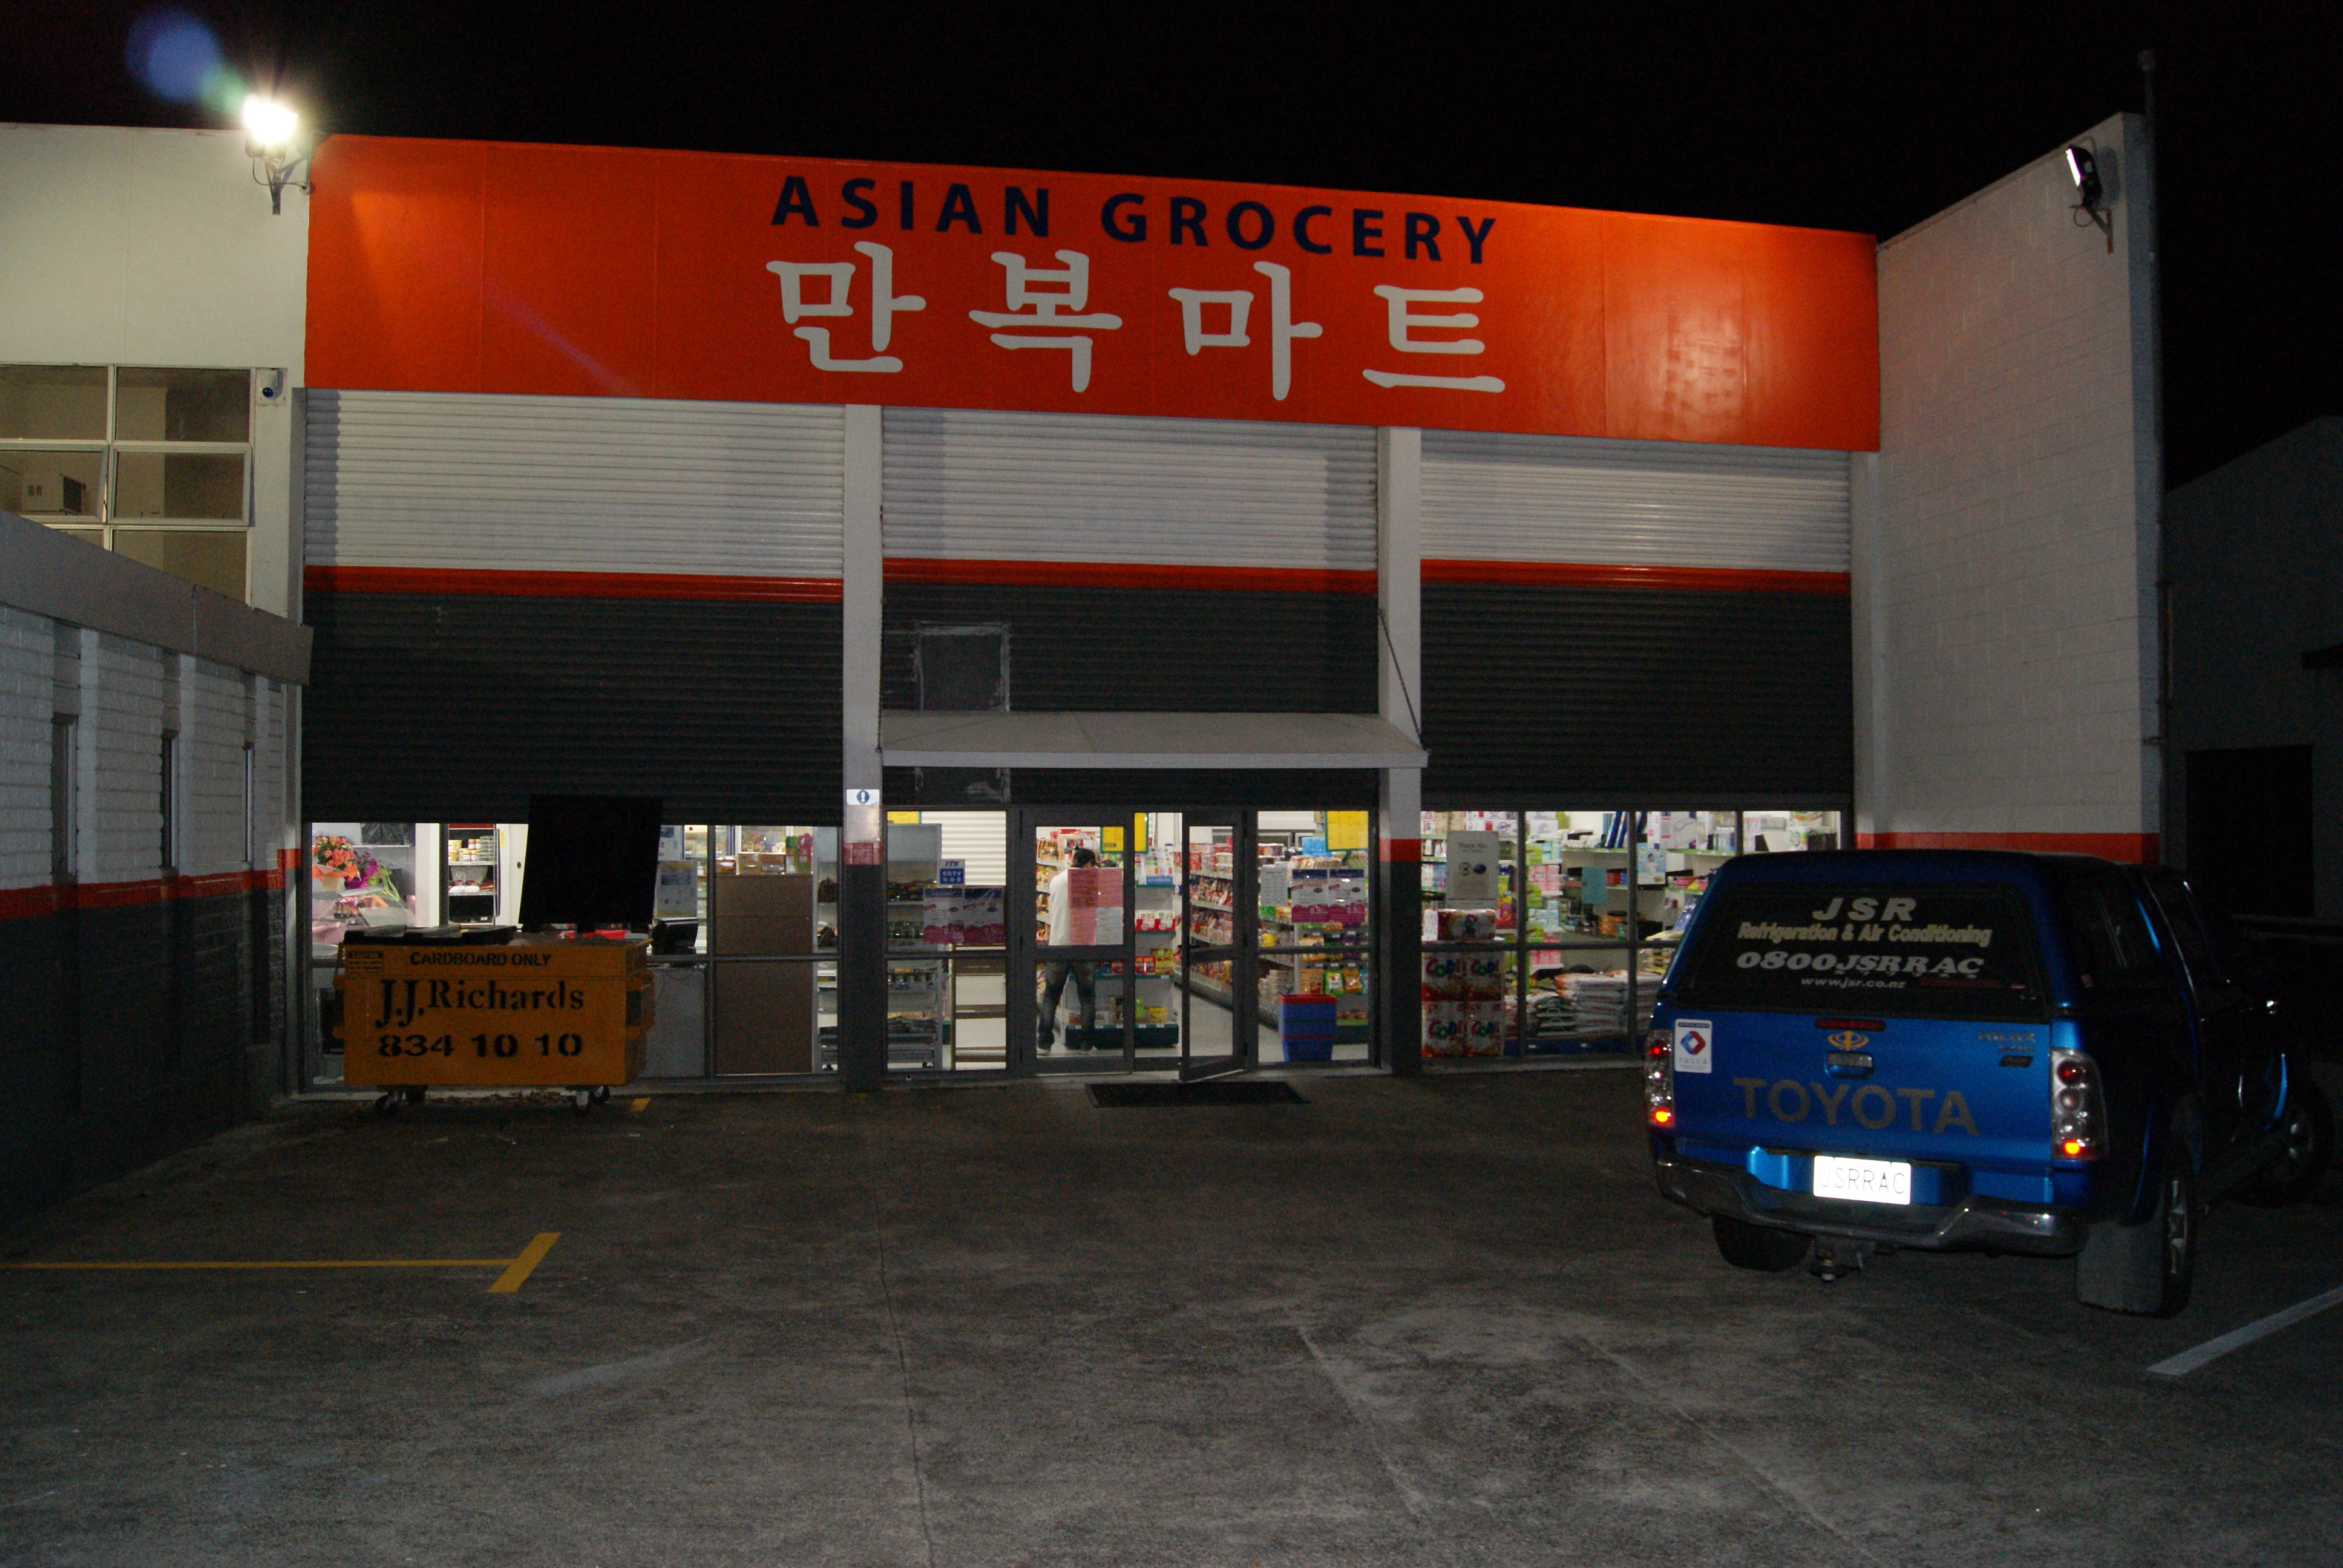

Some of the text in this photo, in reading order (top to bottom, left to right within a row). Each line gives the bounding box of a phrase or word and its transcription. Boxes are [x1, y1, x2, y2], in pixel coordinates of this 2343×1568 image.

[770, 175, 1497, 264] ASIAN GROCERY
[766, 241, 1506, 402] 만복마트
[1812, 897, 1917, 921] JSR
[1737, 921, 1993, 948] Refrigeration & Air Conditioning
[410, 951, 552, 967] CARDBOARD ONLY
[1801, 976, 1907, 990] www.jsr.co.nz
[378, 1033, 583, 1058] 834 10 10
[1732, 1077, 1979, 1136] TOYOTA
[1820, 1168, 1905, 1194] JSRRAC
